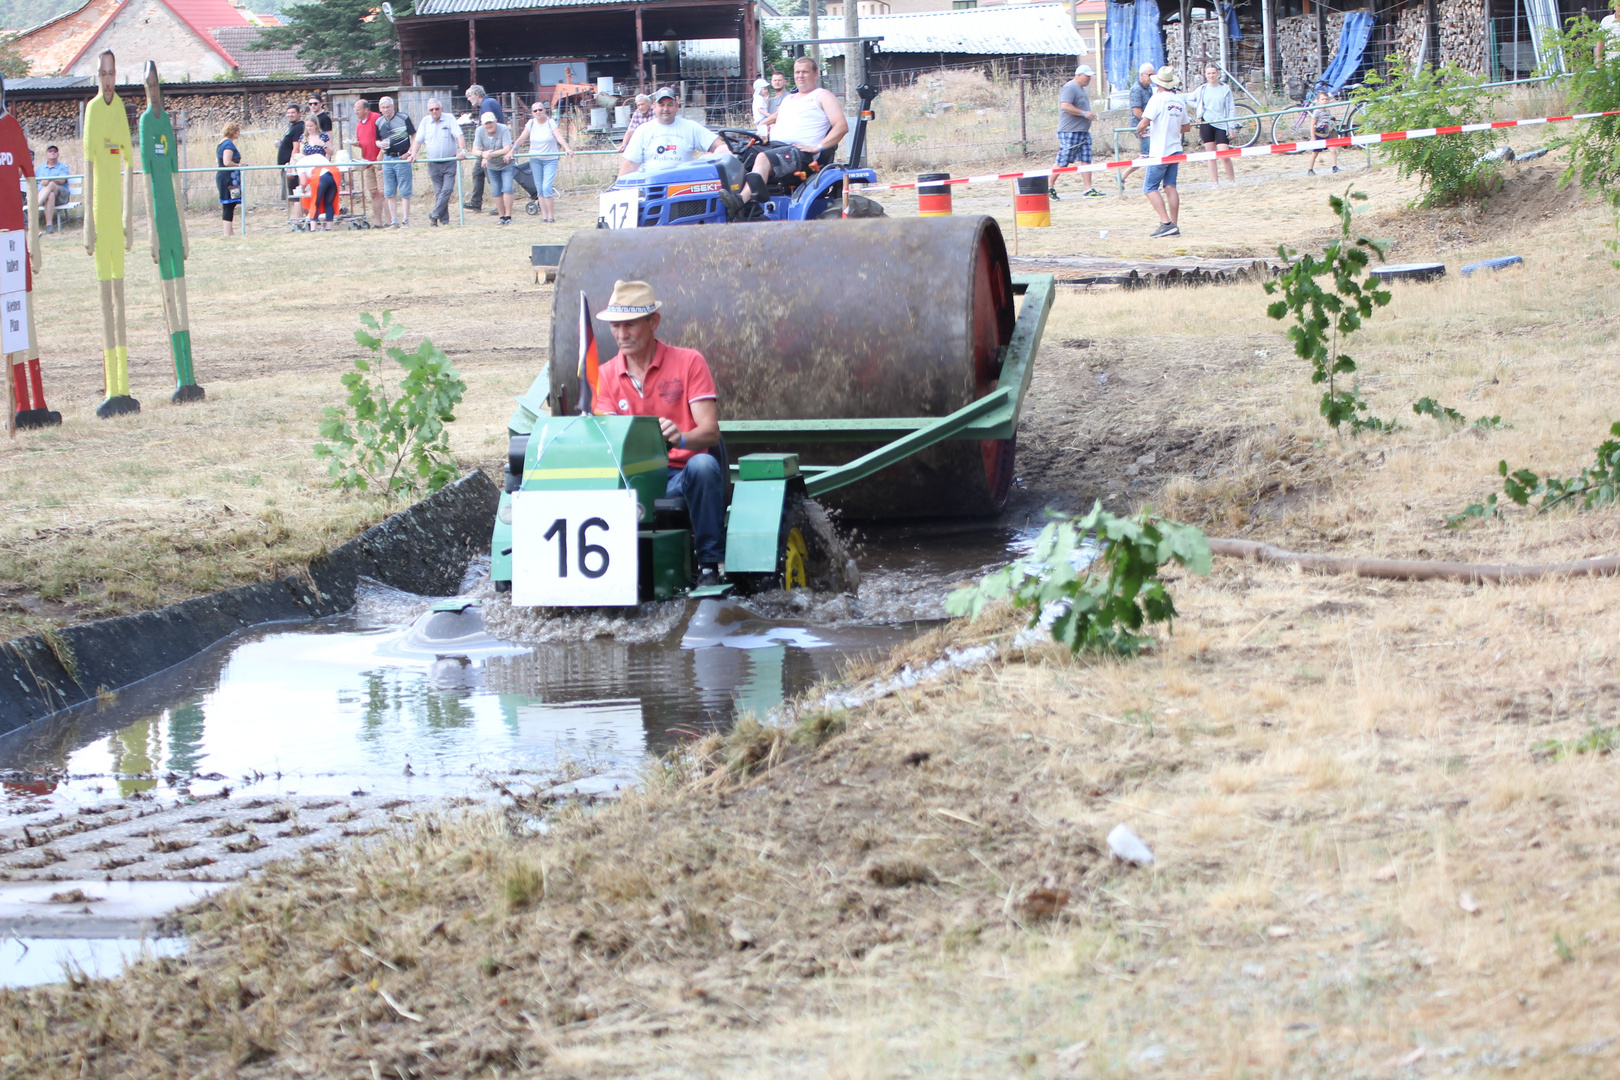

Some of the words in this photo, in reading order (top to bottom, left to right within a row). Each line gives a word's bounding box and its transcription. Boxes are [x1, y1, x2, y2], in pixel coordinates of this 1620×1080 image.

[690, 183, 718, 193] ISEKI
[609, 202, 629, 229] 17
[543, 516, 610, 579] 16
